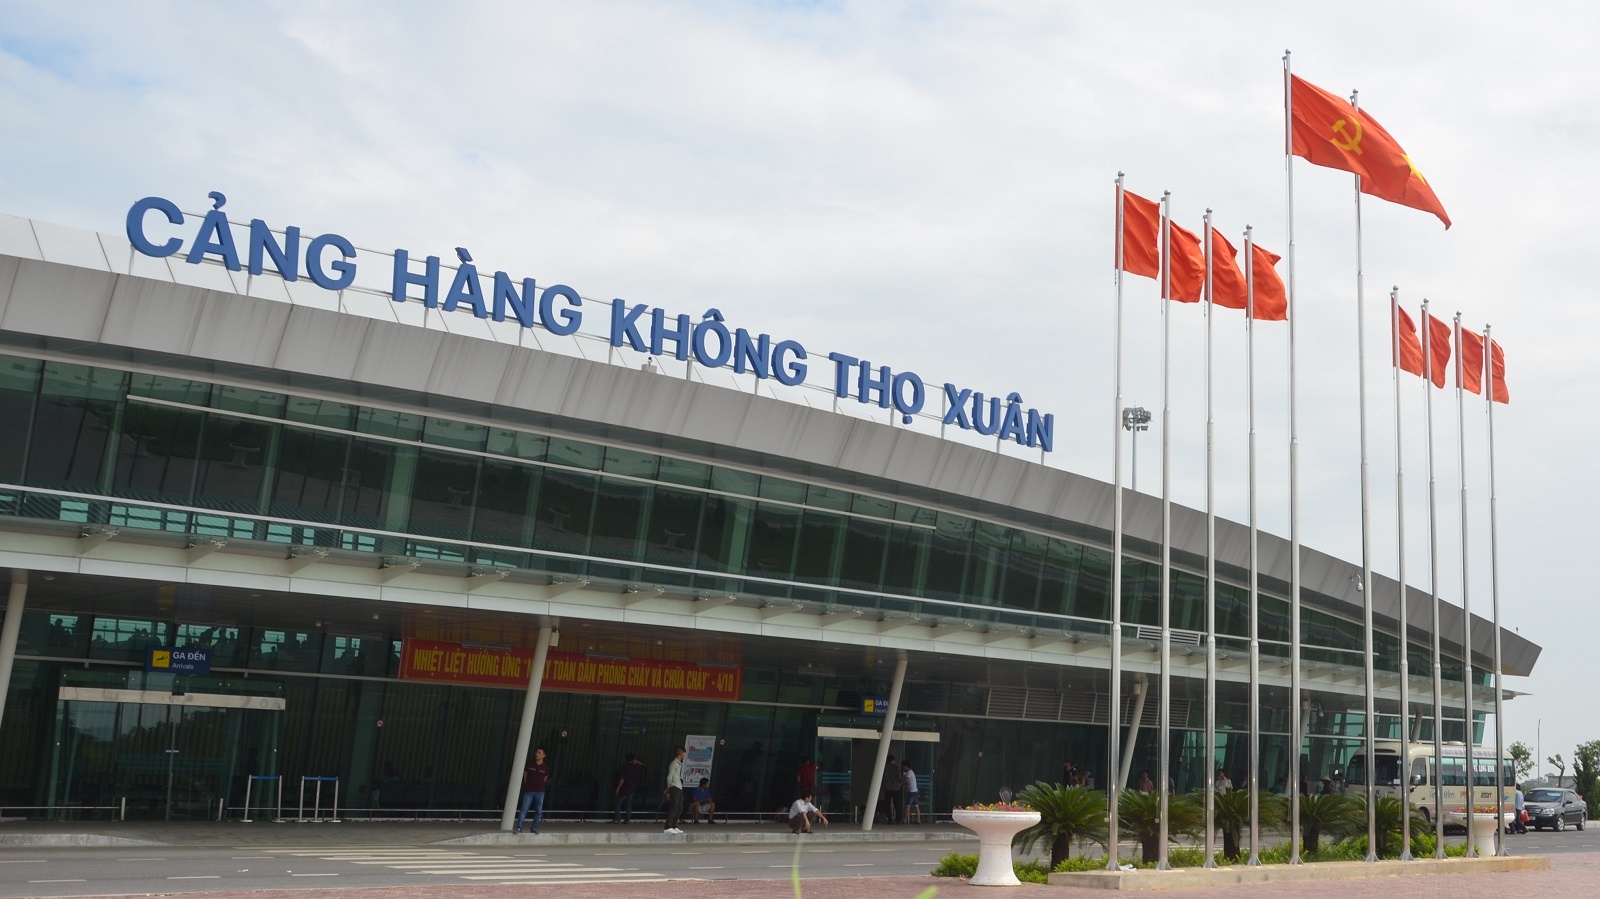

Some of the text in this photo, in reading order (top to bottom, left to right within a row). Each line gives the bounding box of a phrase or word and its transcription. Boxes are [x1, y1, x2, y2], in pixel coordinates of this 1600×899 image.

[126, 191, 1055, 453] CẢNG HÀNG KHÔNG THỌ XUÂN
[172, 650, 206, 660] GA ĐẾN
[413, 646, 444, 677] NHIỆT
[444, 648, 466, 678] LIỆT
[523, 656, 552, 680] "NY
[554, 657, 577, 682] TOÀN
[577, 659, 597, 684] DÂN
[597, 660, 627, 686] PHÒNG
[628, 663, 651, 687] CHÁY
[651, 664, 662, 688] VÀ
[717, 673, 734, 693] 4/10
